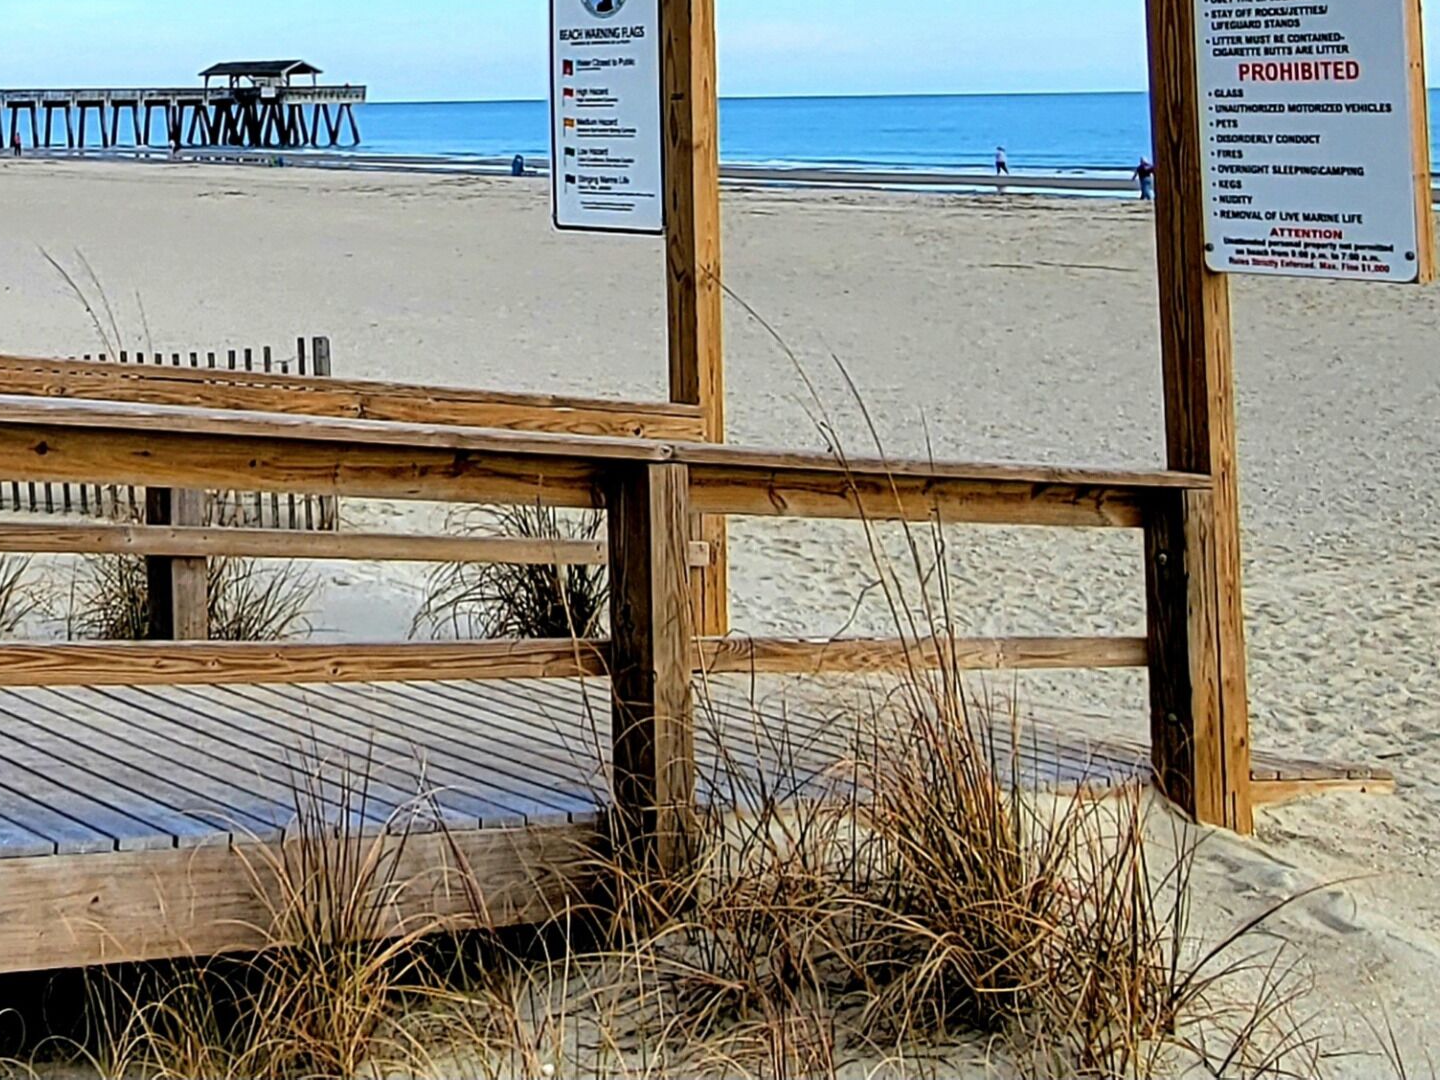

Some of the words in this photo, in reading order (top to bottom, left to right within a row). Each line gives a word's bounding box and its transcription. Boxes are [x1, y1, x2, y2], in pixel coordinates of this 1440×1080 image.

[1211, 9, 1233, 19] STAY
[1235, 8, 1252, 18] OFF
[1211, 21, 1261, 31] LIFEGUARD
[1264, 19, 1300, 28] STANDS
[1212, 36, 1242, 45] LITTER
[1245, 34, 1271, 44] MUST
[1273, 34, 1285, 43] BE
[1212, 47, 1261, 57] CIGARETTE
[1264, 46, 1293, 56] BUTTS
[1295, 45, 1313, 55] ARE
[1316, 45, 1349, 54] LITTER
[1238, 61, 1361, 81] PROHIBITED
[1214, 89, 1244, 98] GLASS
[1215, 104, 1286, 113] UNAUTHORIZED
[1287, 103, 1343, 113] MOTORIZED
[1345, 103, 1392, 113] VEHICLES
[1215, 119, 1238, 129] PETS
[1216, 134, 1274, 144] DISORDERLY
[1276, 134, 1320, 144] CONDUCT
[1217, 150, 1243, 159] FIRES
[1218, 165, 1270, 174] OVERNIGHT
[1218, 180, 1242, 189] KEGS
[1218, 195, 1253, 205] NUDITY
[1220, 210, 1263, 221] REMOVAL
[1264, 211, 1276, 221] OF
[1279, 212, 1300, 222] LIVE
[1302, 212, 1340, 223] MARINE
[1342, 214, 1363, 224] LIFE
[1270, 227, 1343, 240] ATTENTION
